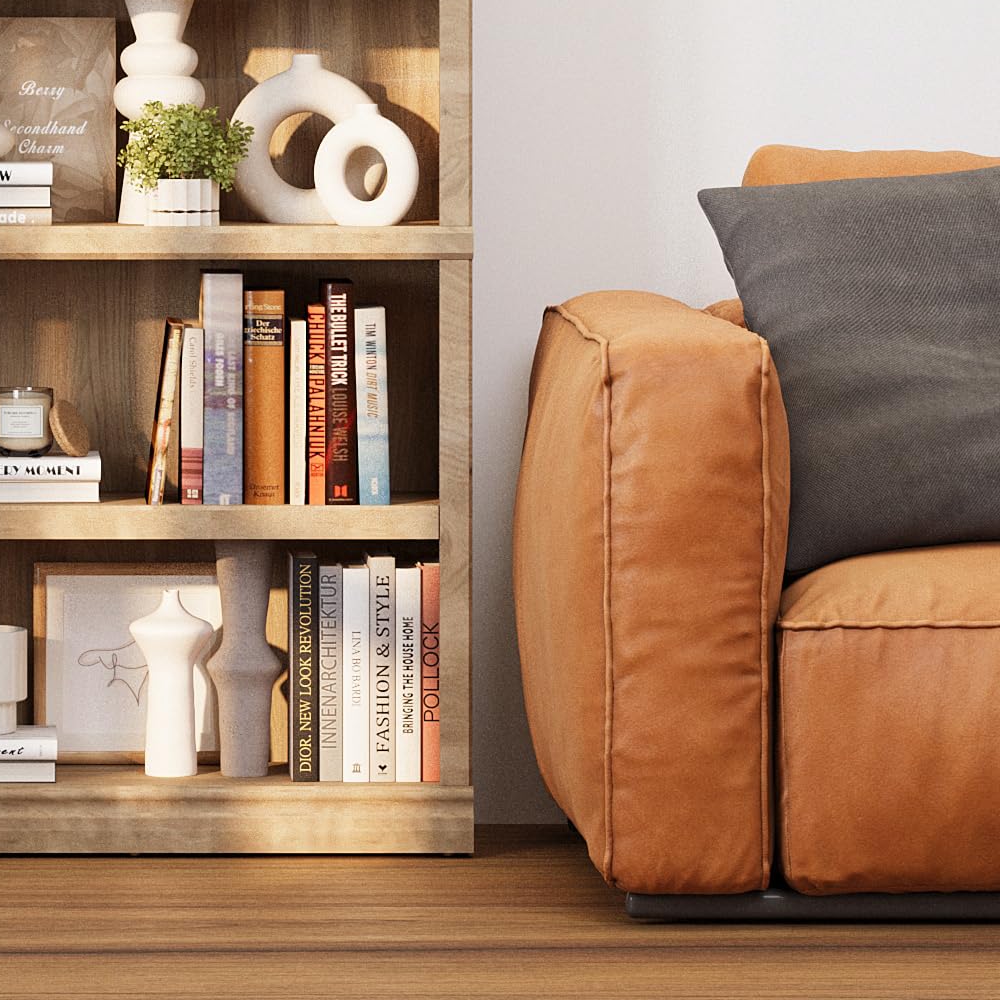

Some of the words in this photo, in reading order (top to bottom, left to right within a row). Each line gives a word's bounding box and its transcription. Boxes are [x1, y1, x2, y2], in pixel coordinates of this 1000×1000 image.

[18, 80, 65, 100] Berry
[18, 138, 65, 155] Charm
[330, 293, 347, 314] THE
[308, 313, 325, 360] CHUCK
[330, 314, 348, 353] BULLET
[365, 323, 377, 337] TIM
[331, 353, 348, 386] TRICK
[365, 340, 378, 370] WINTON
[365, 373, 378, 390] DIRT
[308, 379, 325, 459] PALAHNIUK
[331, 387, 348, 424] LOUISE
[366, 393, 379, 418] MUSIC
[332, 427, 349, 462] WELSH
[24, 465, 81, 476] MOMENT
[299, 564, 312, 654] REVOLUTION
[376, 575, 390, 637] STYLE
[351, 631, 361, 655] LINA
[402, 616, 414, 640] HOME
[320, 574, 337, 748] INNENARCHITEKTUR
[351, 658, 361, 672] BO
[376, 643, 390, 658] &
[402, 642, 414, 671] HOUSE
[299, 656, 312, 696] LOOK
[402, 673, 414, 691] THE
[422, 622, 440, 722] POLLOCK
[351, 675, 361, 706] BARDI
[299, 700, 312, 731] NEW
[376, 664, 390, 752] FASHION
[402, 692, 414, 734] BRINGING
[299, 734, 312, 773] DIOR.
